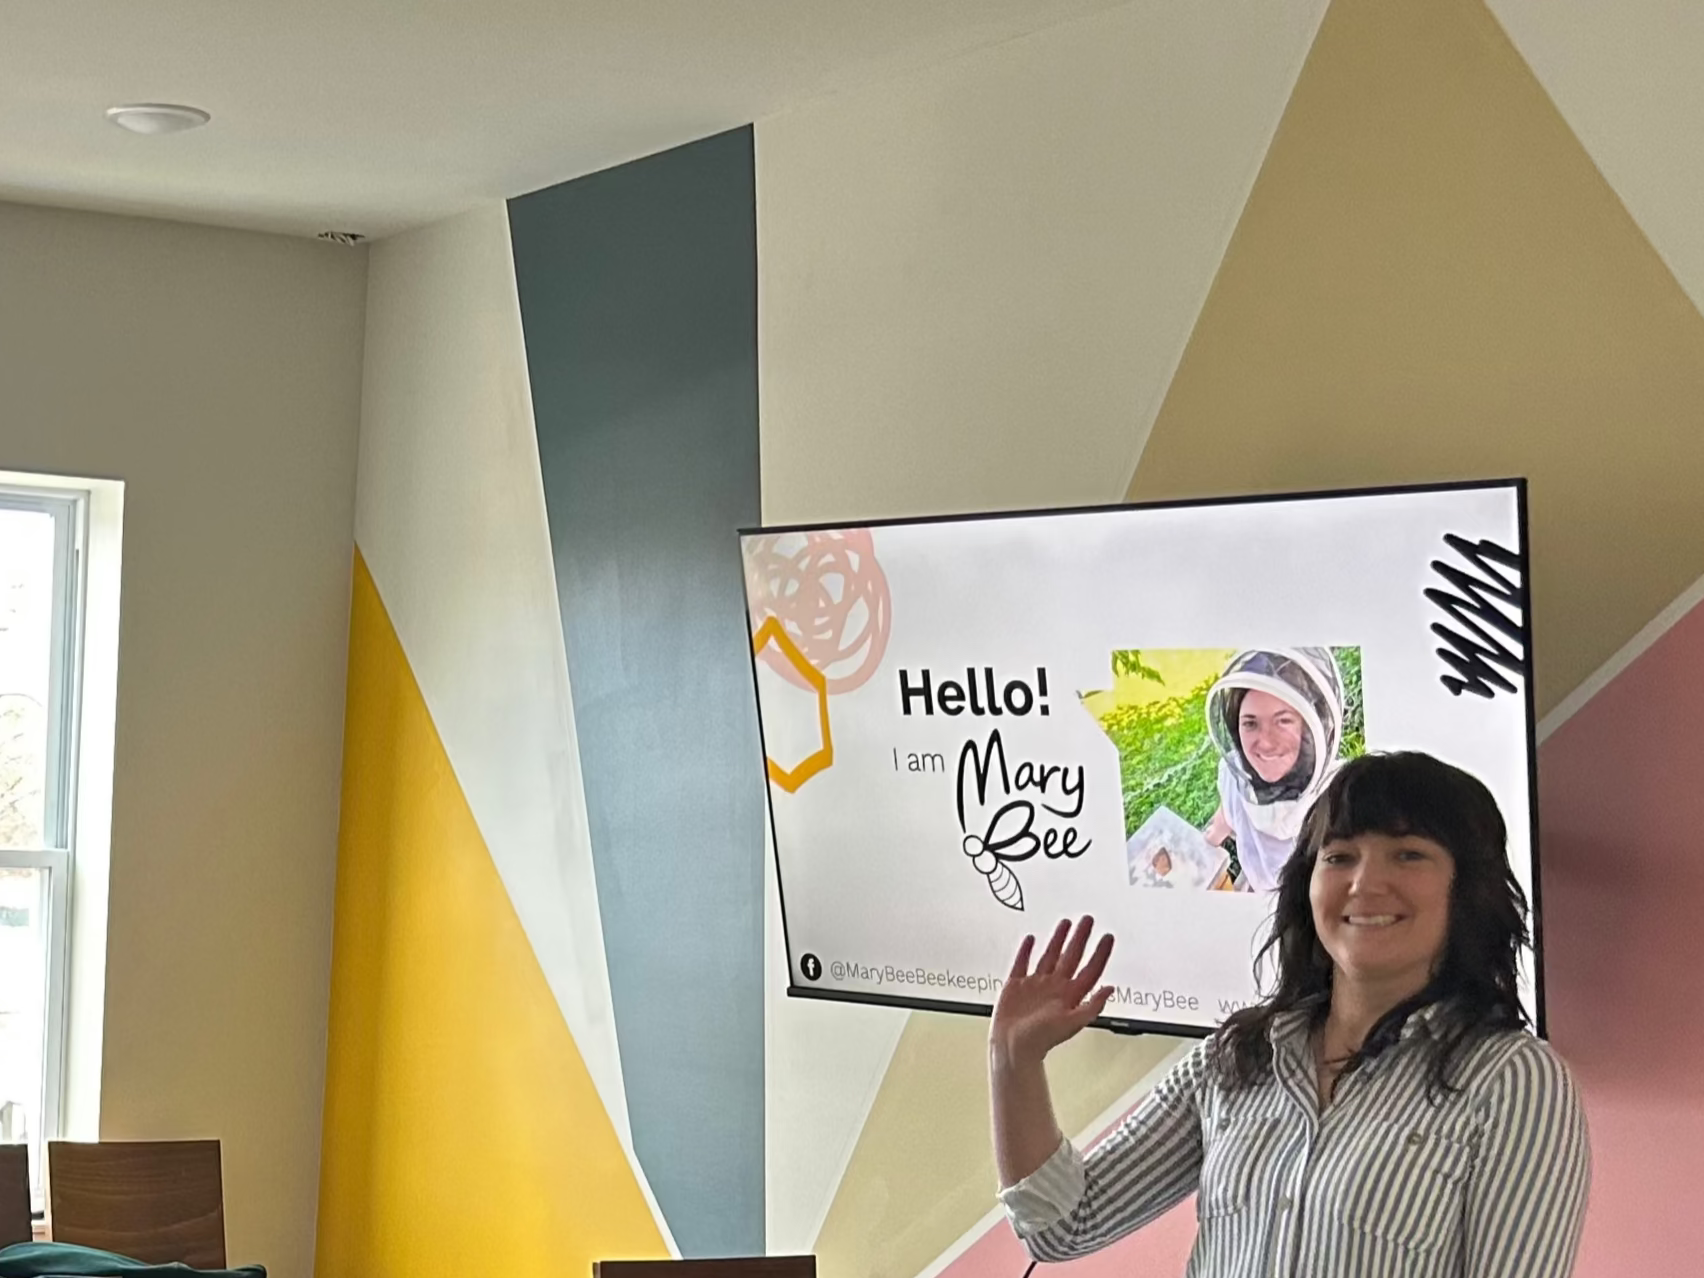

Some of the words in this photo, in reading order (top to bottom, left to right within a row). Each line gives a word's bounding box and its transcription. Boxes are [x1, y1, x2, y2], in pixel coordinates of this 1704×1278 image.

[898, 666, 1050, 717] Hello!
[892, 747, 899, 772] I
[907, 752, 945, 773] am
[956, 728, 1084, 834] Mary
[983, 799, 1093, 862] Bee
[829, 960, 1005, 995] @MaryBeeBeekeepin
